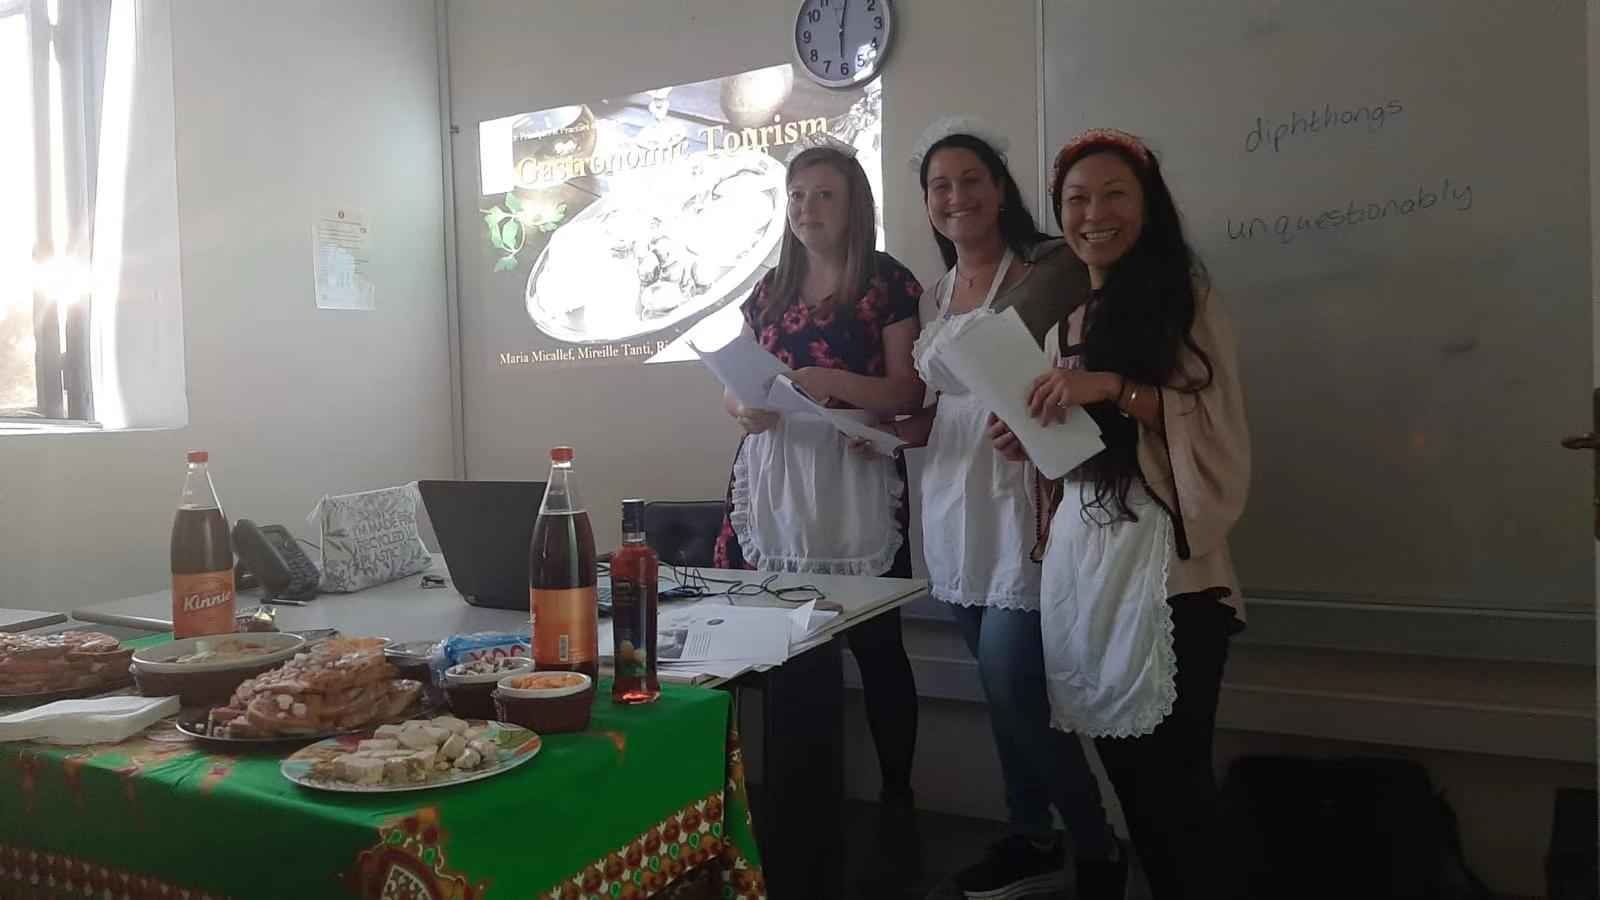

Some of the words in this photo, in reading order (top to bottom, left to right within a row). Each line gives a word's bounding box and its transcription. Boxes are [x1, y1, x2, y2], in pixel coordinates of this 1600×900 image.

[866, 0, 876, 11] 2
[807, 9, 821, 23] 10
[873, 16, 883, 30] 3
[803, 30, 812, 44] 9
[810, 49, 819, 62] 8
[857, 54, 866, 67] 5
[823, 60, 832, 73] 7
[840, 62, 850, 76] 6
[1245, 98, 1404, 153] diphthongs
[702, 115, 828, 156] Tourism
[1226, 177, 1474, 245] unquestionably
[500, 352, 529, 365] Maria
[531, 348, 576, 363] Micallef,
[578, 346, 620, 361] Mireille
[621, 341, 655, 356] Tanti,
